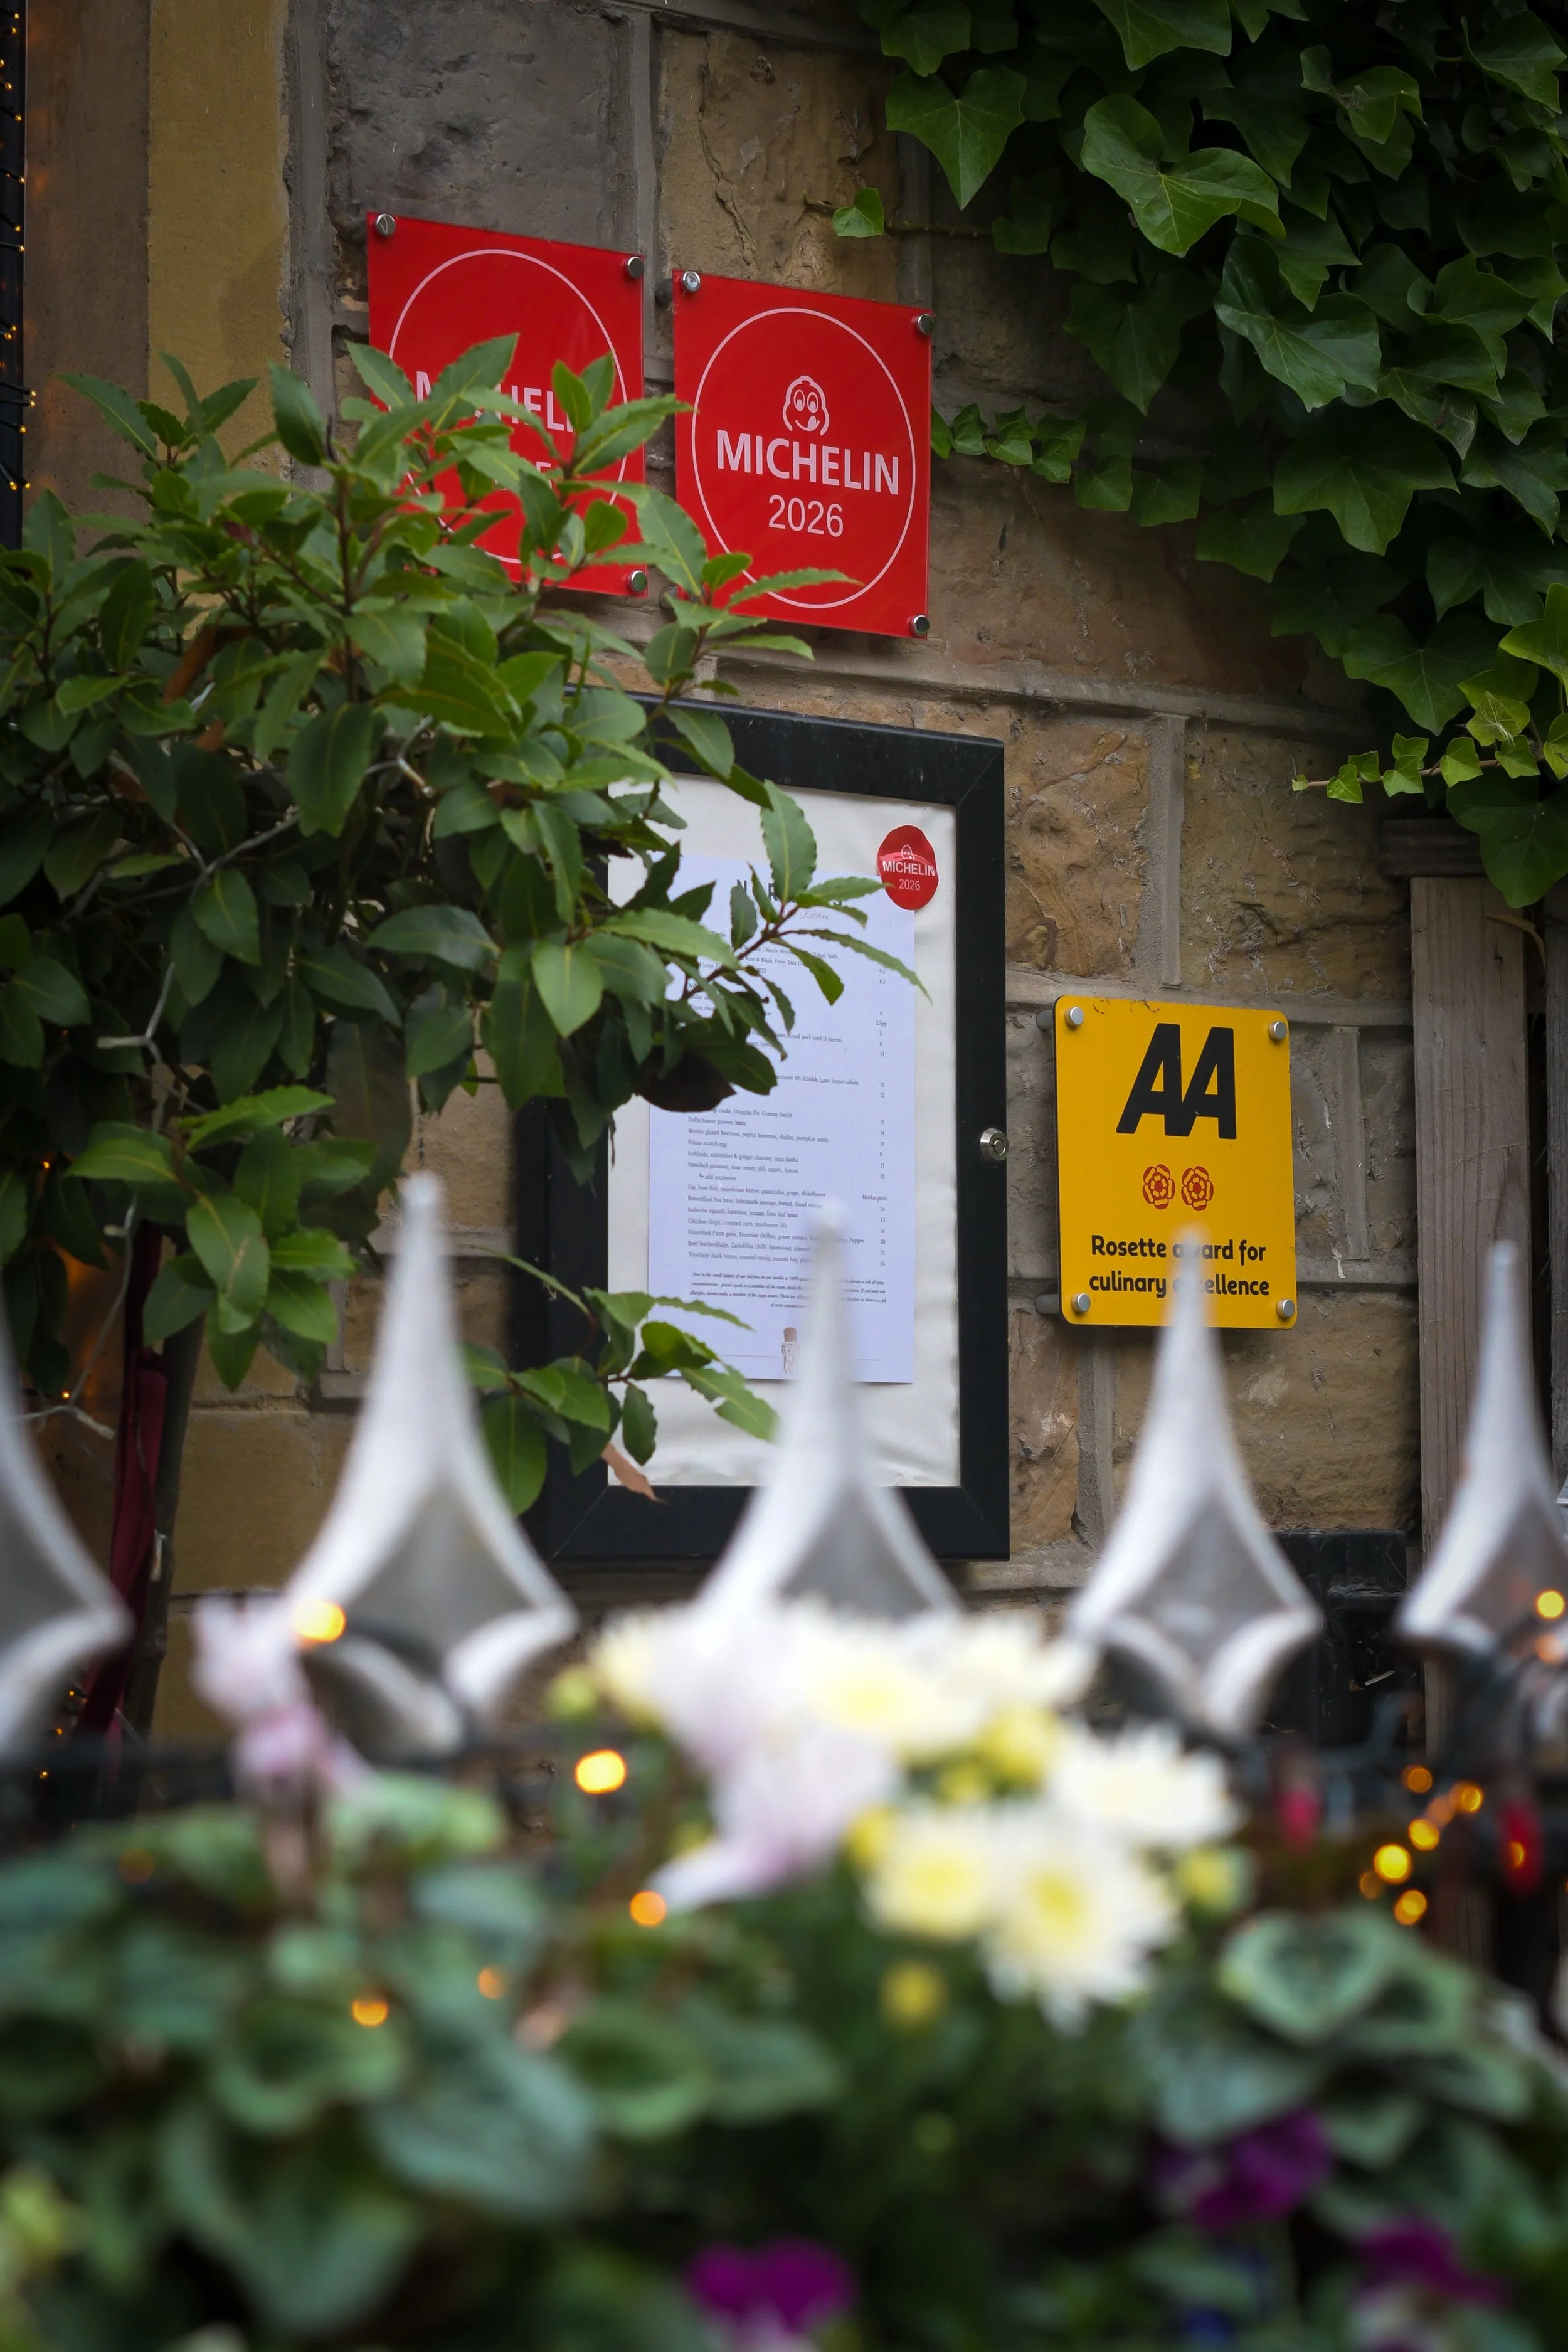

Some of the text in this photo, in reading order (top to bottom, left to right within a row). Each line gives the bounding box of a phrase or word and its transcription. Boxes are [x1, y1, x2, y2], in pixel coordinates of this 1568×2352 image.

[717, 430, 898, 495] MICHELIN
[769, 495, 844, 537] 2026
[882, 861, 935, 877] MICHELIN
[899, 879, 921, 891] 2026
[1116, 1023, 1237, 1140] AA
[1091, 1234, 1267, 1266] Rosette aard for
[1089, 1270, 1270, 1299] culinary eellence
